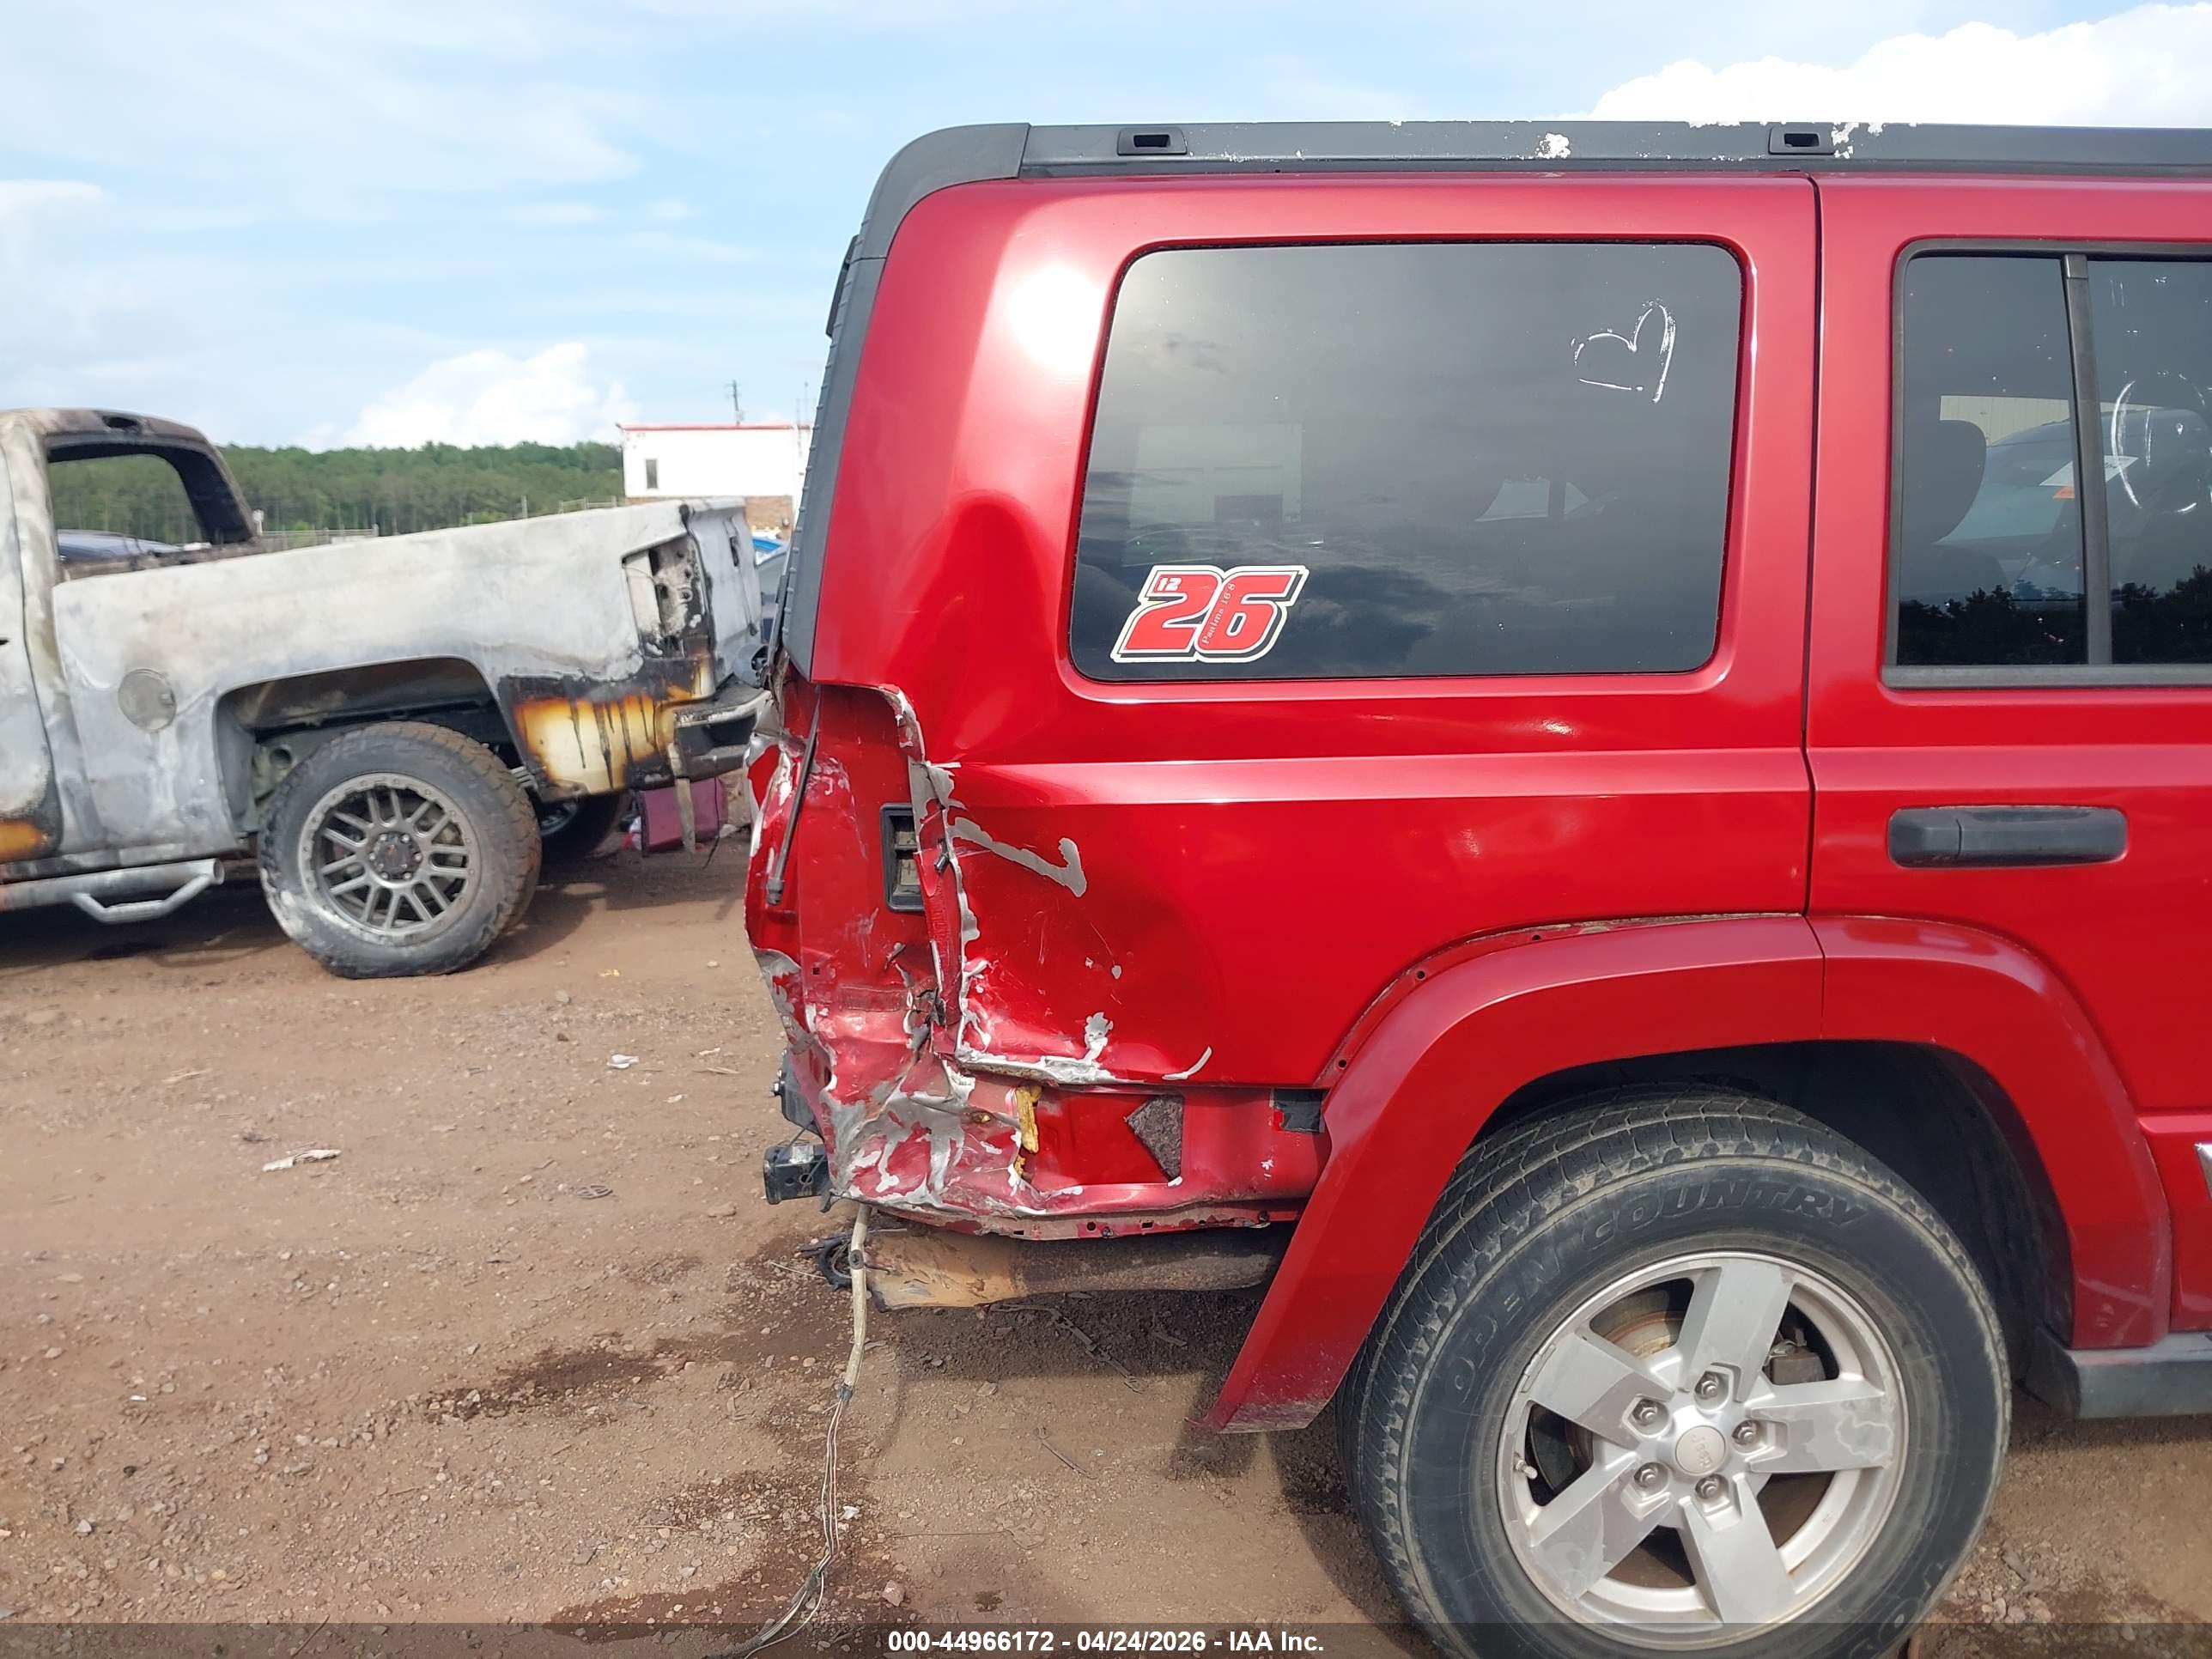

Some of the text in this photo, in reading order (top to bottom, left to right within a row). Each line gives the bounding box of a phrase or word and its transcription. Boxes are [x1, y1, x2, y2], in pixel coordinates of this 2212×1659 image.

[1110, 565, 1310, 663] 26
[1157, 577, 1182, 592] 12
[1581, 1179, 1868, 1250] COUNTRY
